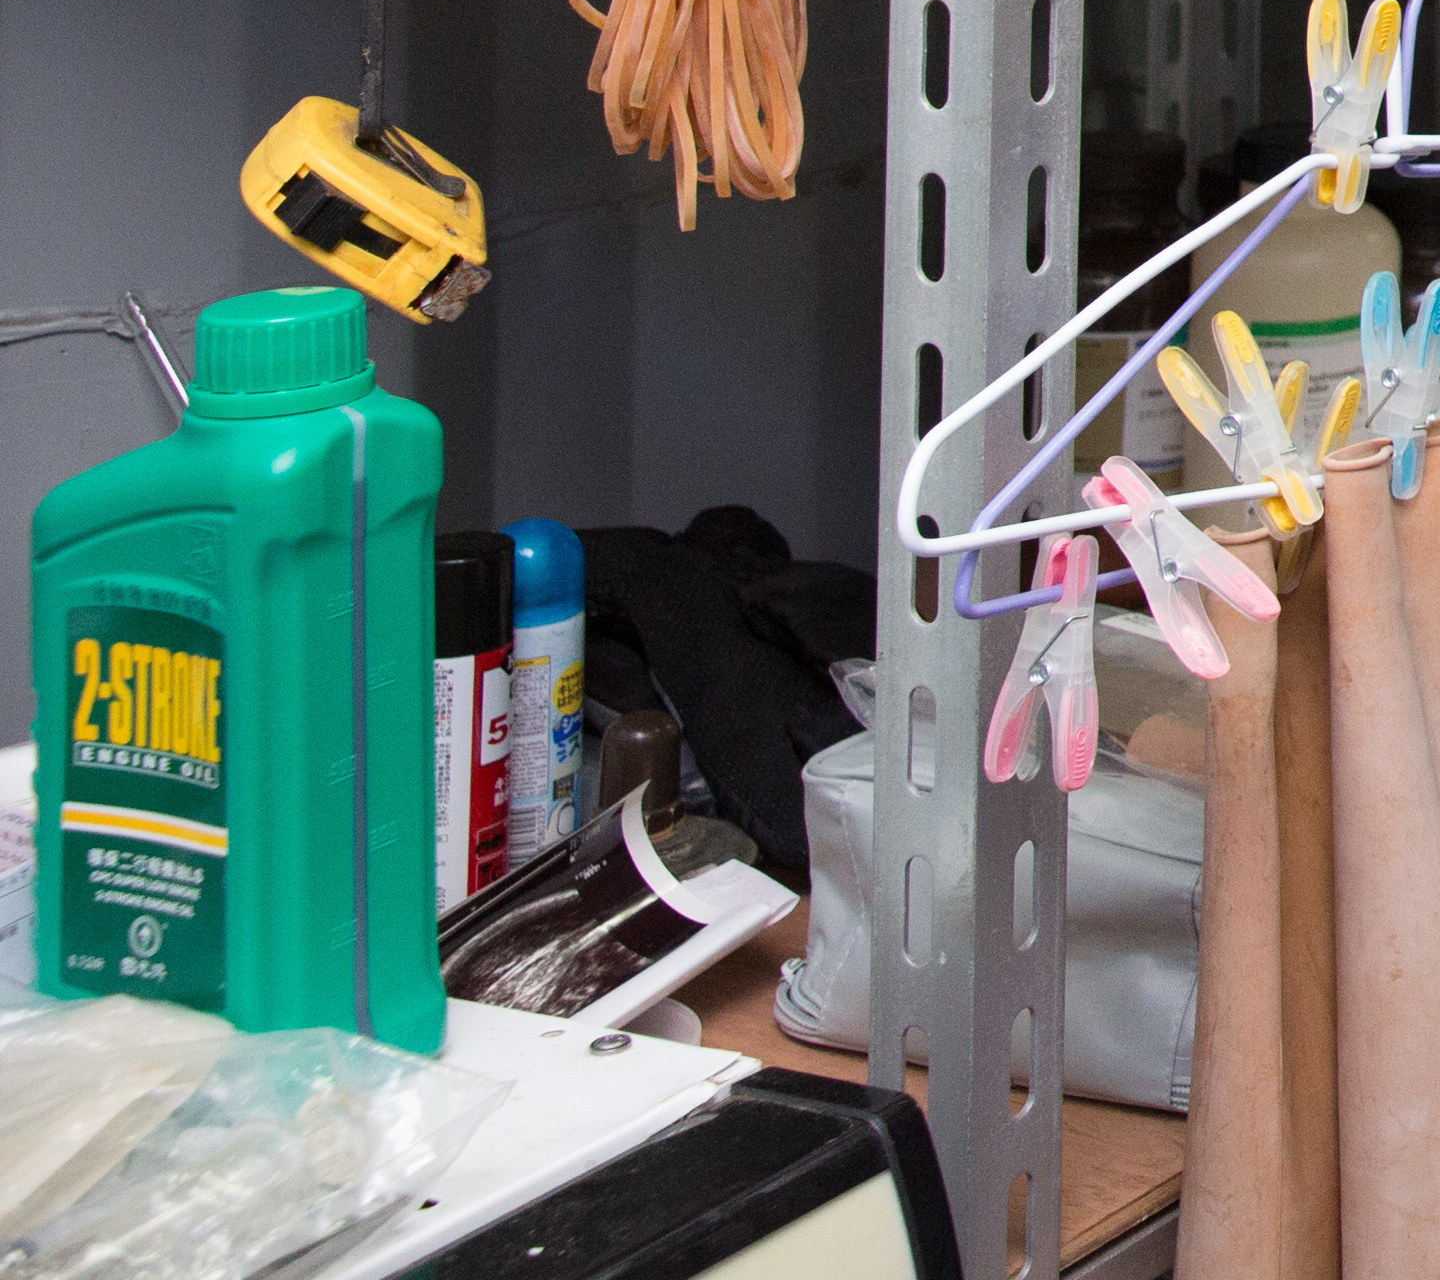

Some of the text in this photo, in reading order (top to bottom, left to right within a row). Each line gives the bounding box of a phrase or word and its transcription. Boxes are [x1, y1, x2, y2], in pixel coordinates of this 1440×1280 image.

[73, 638, 221, 763] 2-STROKE
[80, 745, 215, 782] ENGINE OIL
